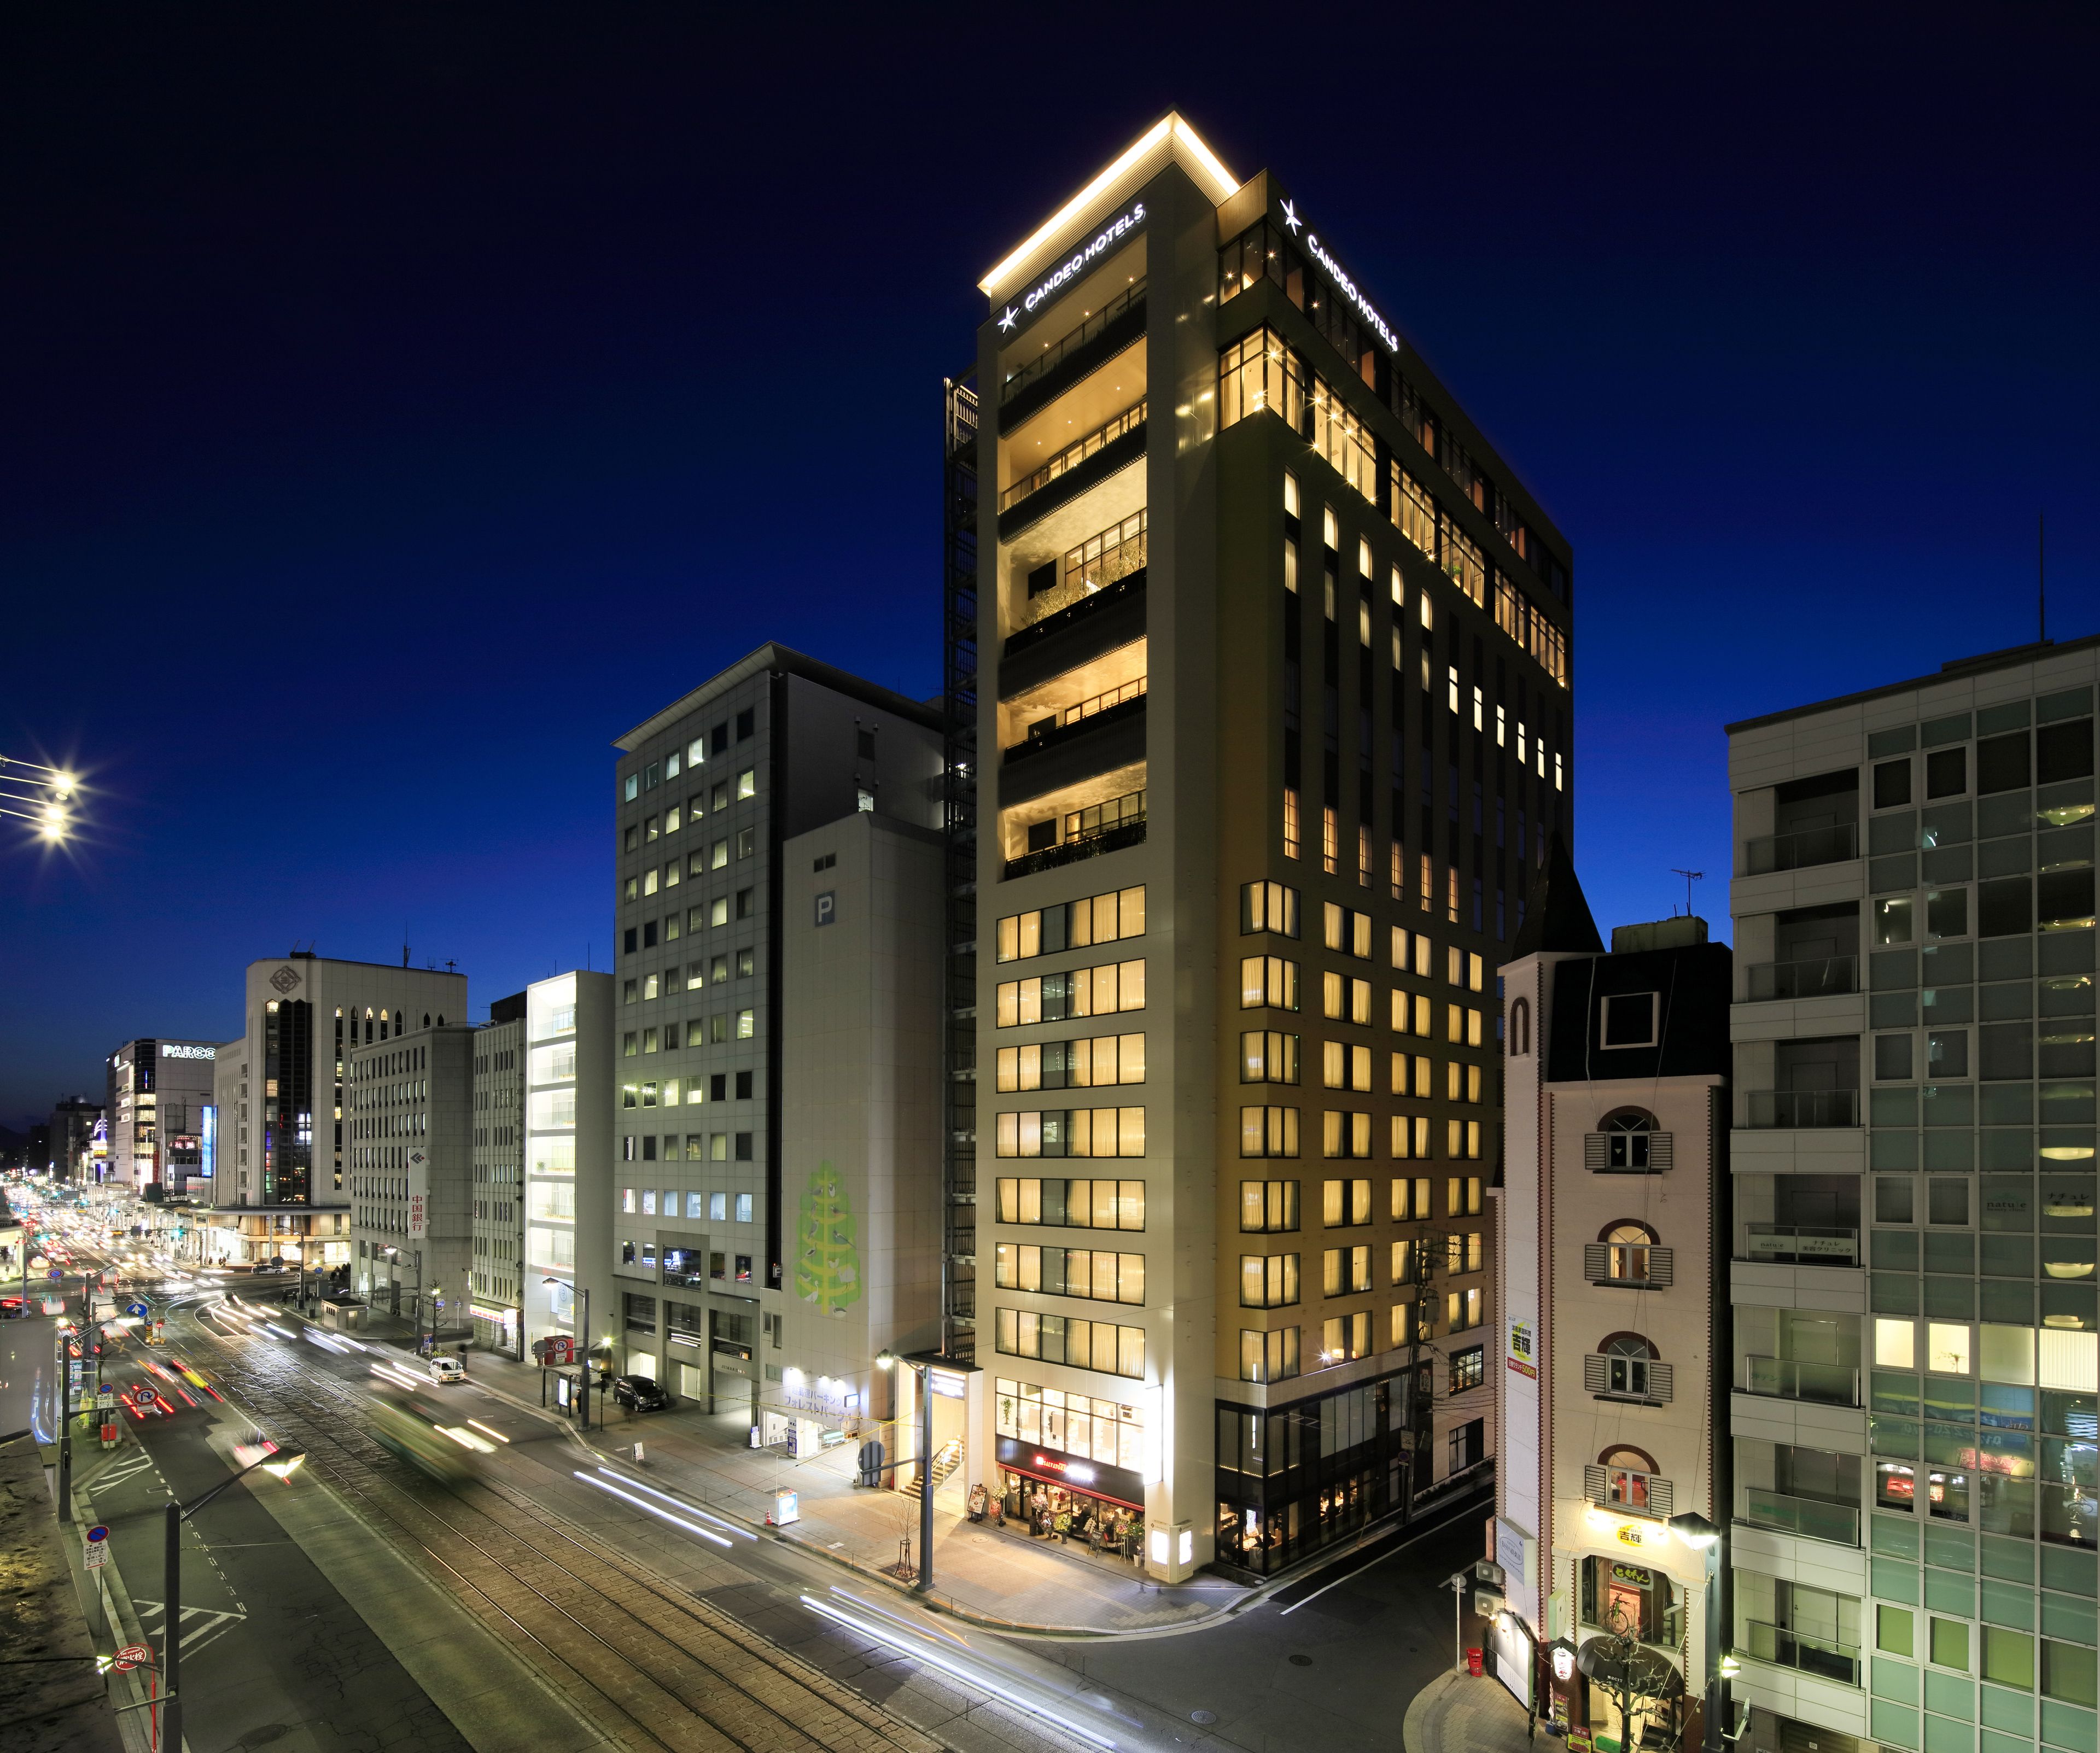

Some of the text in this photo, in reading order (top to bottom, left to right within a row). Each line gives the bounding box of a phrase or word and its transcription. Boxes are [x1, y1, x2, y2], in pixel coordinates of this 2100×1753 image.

[1025, 203, 1146, 311] CANDEO HOTELS
[1308, 235, 1399, 352] CANDEO HOTELS
[818, 895, 832, 923] P
[2047, 1192, 2090, 1200] ナチュレ
[412, 1195, 423, 1231] 中国銀行
[1512, 1333, 1531, 1356] 吉輝
[1522, 1364, 1536, 1377] 500円
[1619, 1530, 1642, 1544] 吉輝
